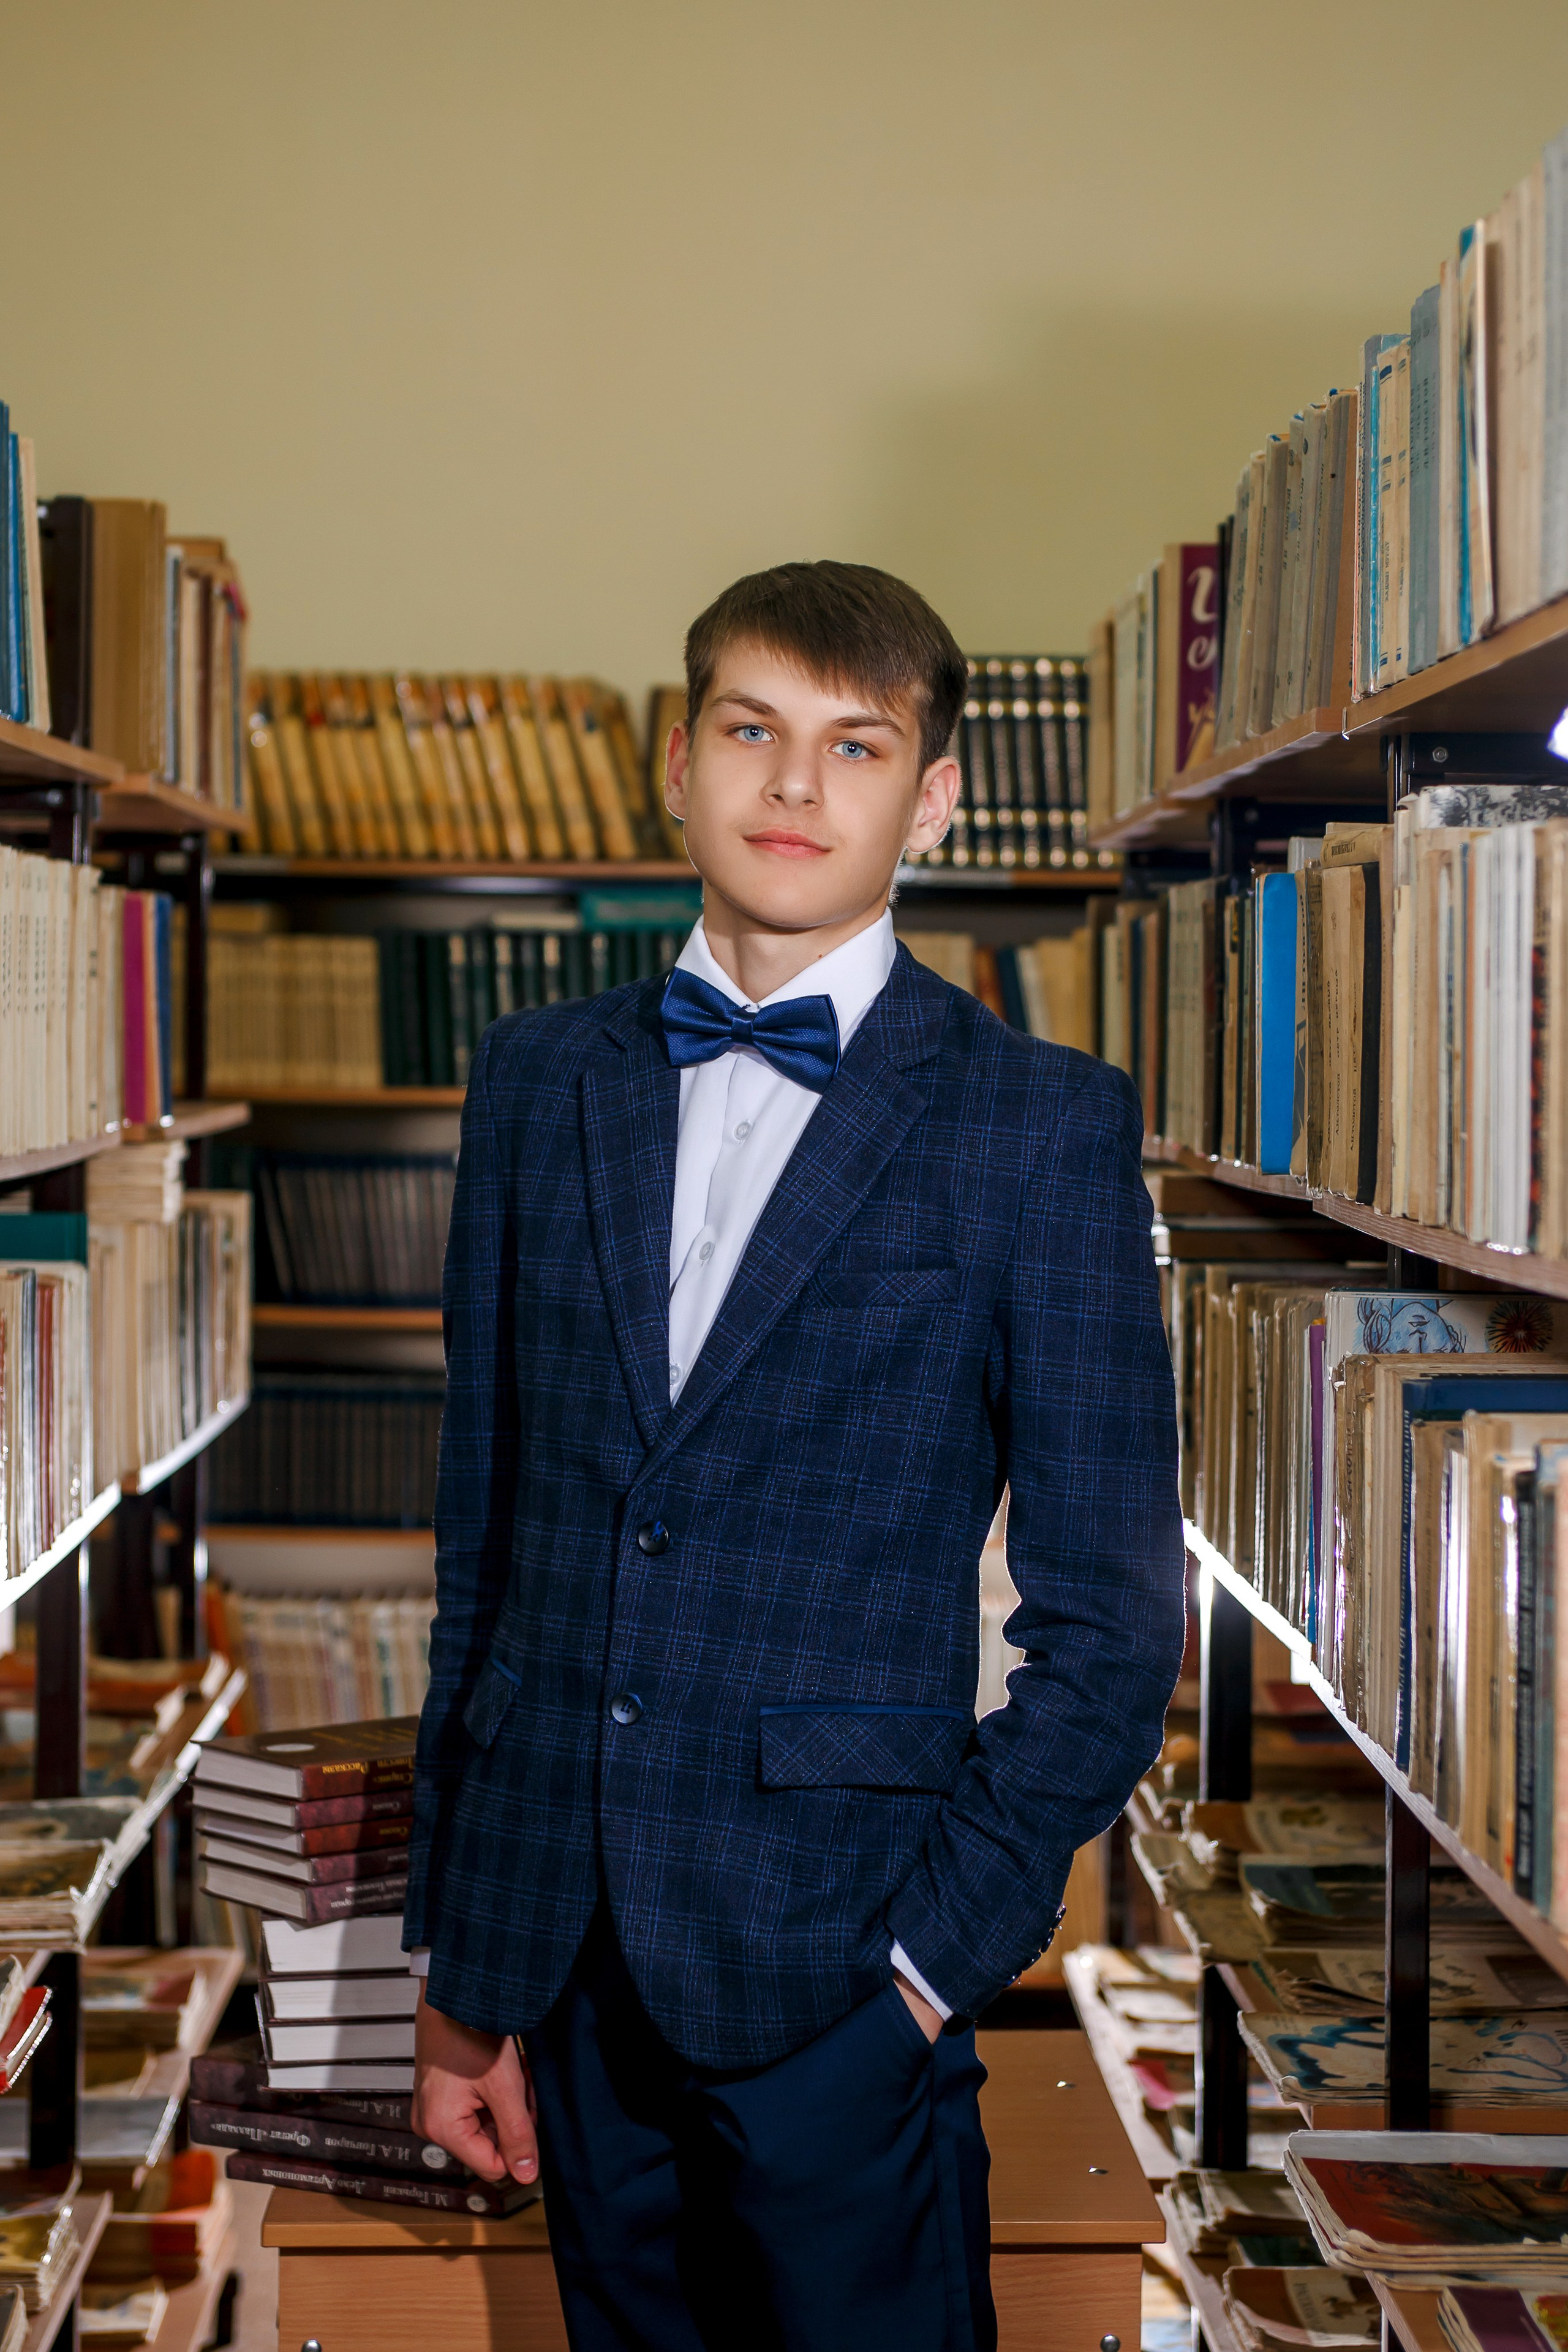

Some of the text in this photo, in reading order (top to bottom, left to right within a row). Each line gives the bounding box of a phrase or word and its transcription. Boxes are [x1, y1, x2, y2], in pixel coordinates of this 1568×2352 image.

[322, 1760, 369, 1774] Рассказы
[269, 2128, 311, 2148] Фрегат
[324, 2137, 376, 2157] Гончаров
[262, 2168, 336, 2190] Артамоновых
[336, 2179, 367, 2195] Дело
[383, 2185, 429, 2204] Горький
